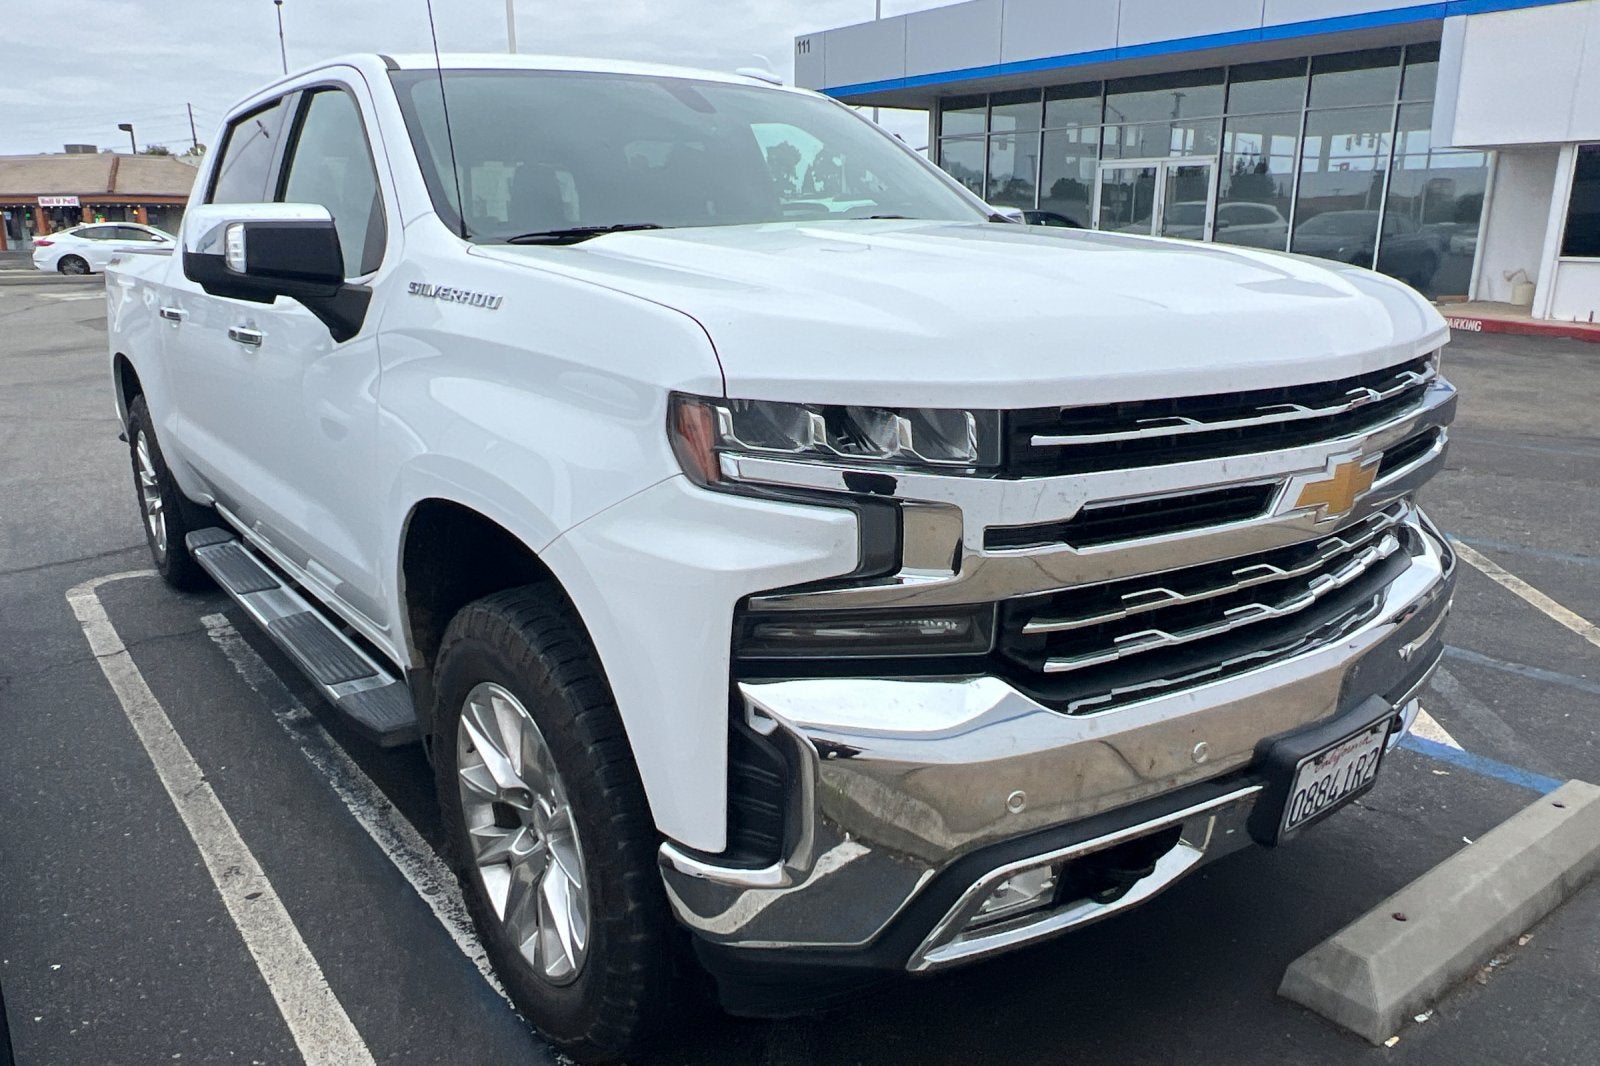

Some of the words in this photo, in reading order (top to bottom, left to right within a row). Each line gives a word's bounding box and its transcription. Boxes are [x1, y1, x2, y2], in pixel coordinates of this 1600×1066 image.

[797, 39, 810, 55] 111
[407, 281, 503, 310] SILVERADO
[1288, 747, 1379, 828] 08841R2
